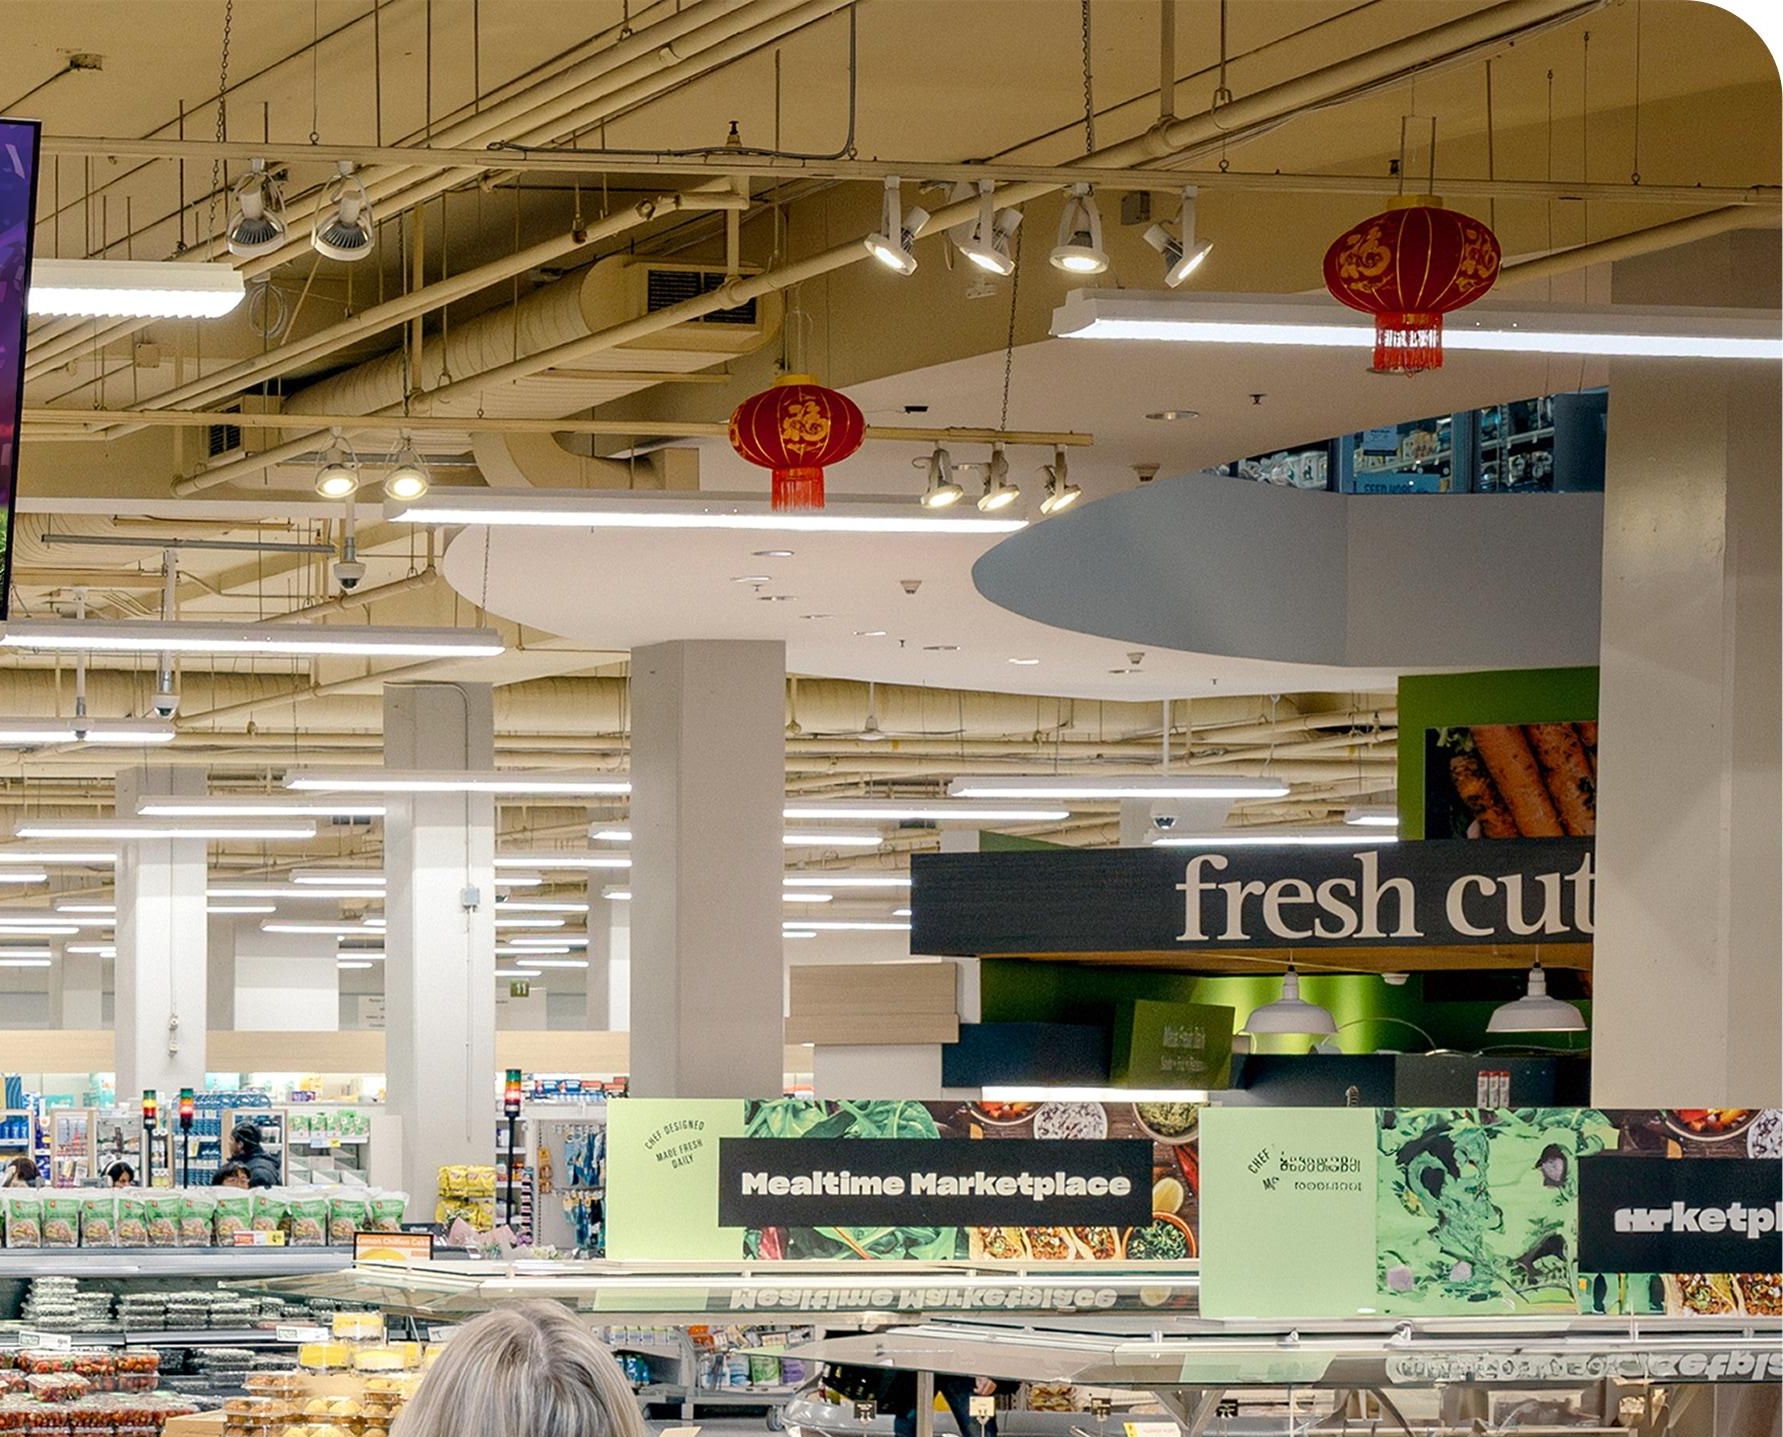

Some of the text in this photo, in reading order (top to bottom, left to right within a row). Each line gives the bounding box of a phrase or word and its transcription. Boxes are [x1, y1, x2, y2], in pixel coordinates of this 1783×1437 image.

[1176, 852, 1424, 943] fresh
[516, 983, 527, 994] 11
[644, 1119, 705, 1150] CHEF DESIGNED
[655, 1139, 704, 1161] MADE FRESH
[671, 1153, 694, 1169] DAILY
[1247, 1148, 1270, 1174] CHEF
[741, 1170, 1132, 1202] Mealtime Marketplace
